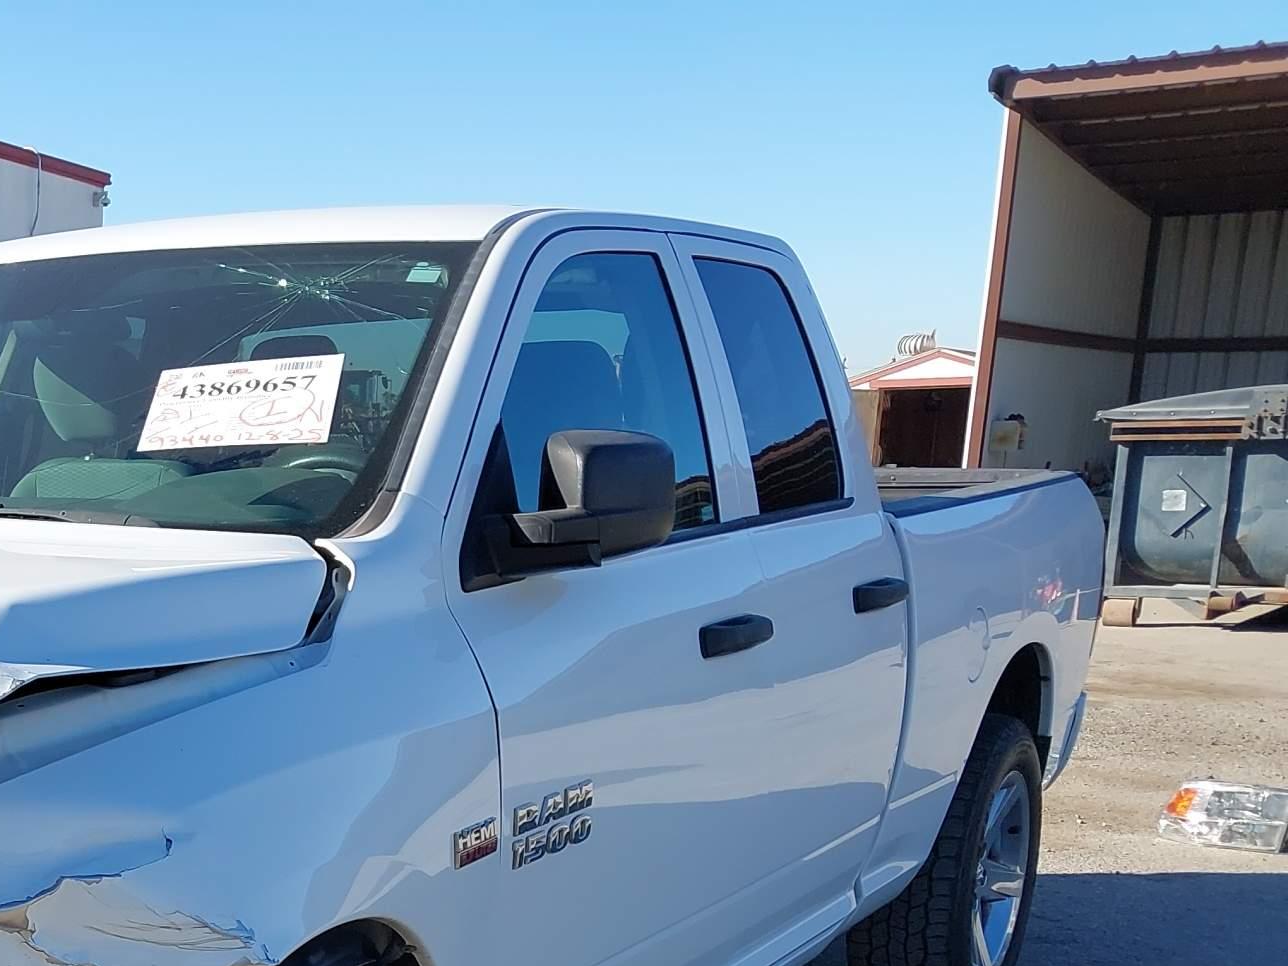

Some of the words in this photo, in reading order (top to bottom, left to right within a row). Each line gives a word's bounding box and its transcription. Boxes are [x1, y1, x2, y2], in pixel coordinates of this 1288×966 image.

[172, 374, 318, 400] 43869657
[513, 778, 593, 836] RAM
[458, 820, 498, 851] HEMI
[512, 814, 592, 870] 1500
